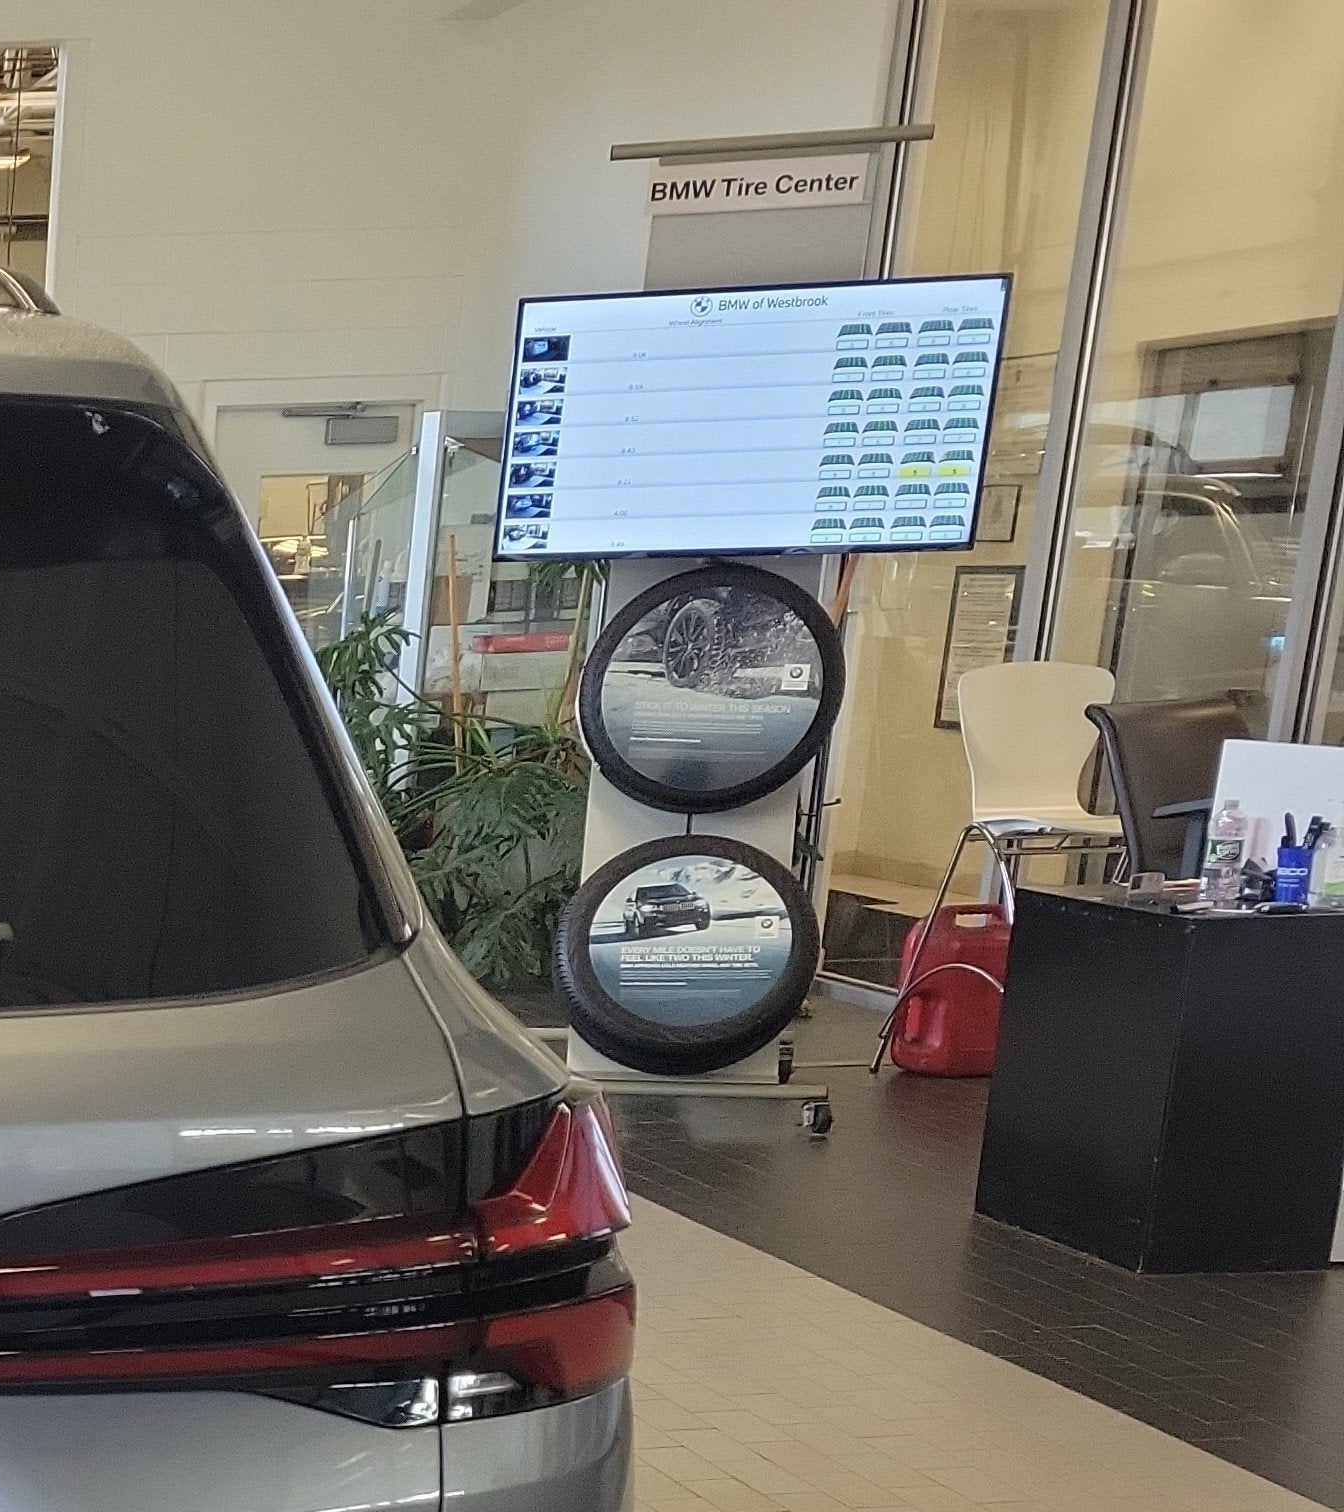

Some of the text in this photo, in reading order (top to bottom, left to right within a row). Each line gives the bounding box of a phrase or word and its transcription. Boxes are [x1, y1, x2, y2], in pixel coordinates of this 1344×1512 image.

[650, 173, 860, 201] BMW Tire Center
[718, 299, 750, 311] BMW
[753, 298, 765, 310] of
[767, 295, 829, 309] Westbrook
[621, 946, 651, 954] EVERY
[719, 945, 746, 953] HAVE
[747, 945, 761, 953] TO
[645, 954, 667, 962] LIKE
[667, 954, 690, 962] TWO
[692, 953, 714, 961] THIS
